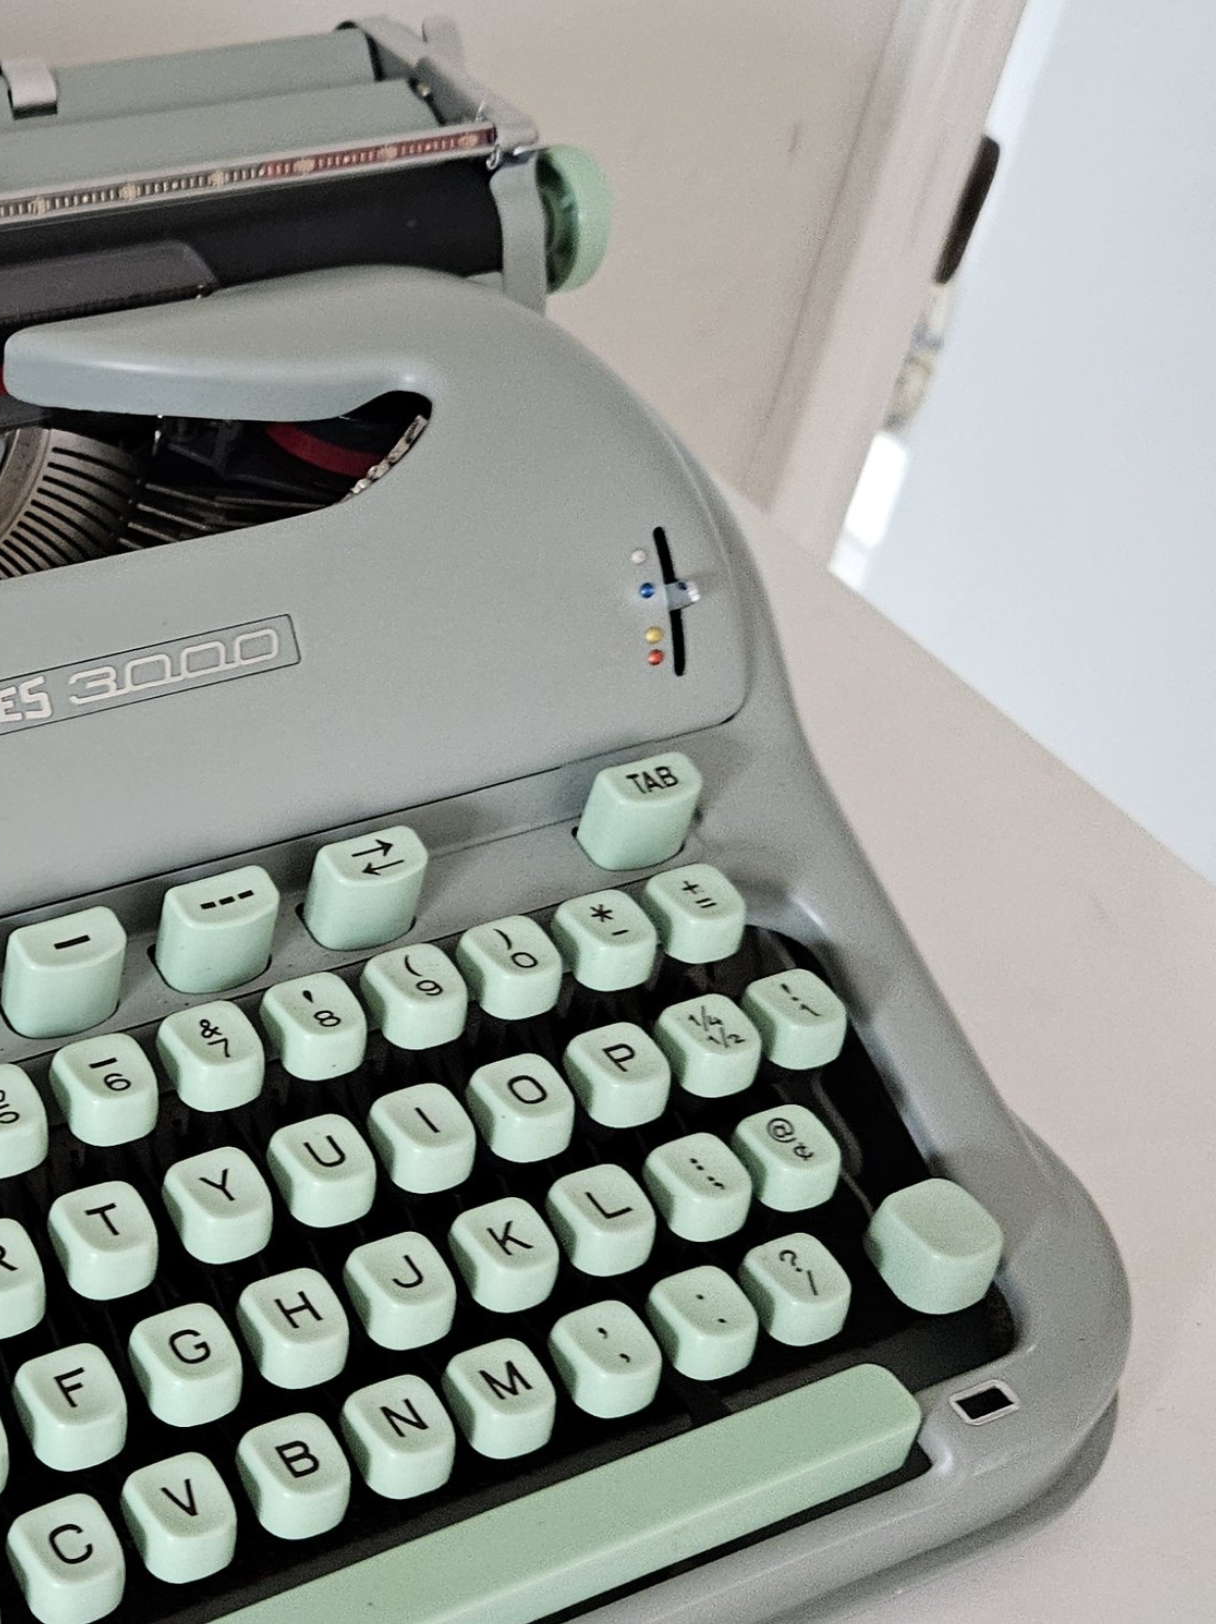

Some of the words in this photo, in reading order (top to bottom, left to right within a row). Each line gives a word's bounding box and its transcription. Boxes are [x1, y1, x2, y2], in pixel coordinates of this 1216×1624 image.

[68, 628, 279, 704] 3000
[626, 766, 679, 794] TAB
[414, 979, 444, 997] 9
[312, 1009, 342, 1028] 8
[205, 1036, 232, 1059] 7
[601, 1043, 636, 1073] P
[102, 1072, 132, 1092] 6
[766, 1117, 797, 1144] @
[302, 1134, 347, 1168] U
[198, 1168, 236, 1202] Y
[84, 1202, 121, 1237] T
[584, 1191, 634, 1220] L
[485, 1220, 534, 1257] K
[391, 1254, 425, 1289] J
[273, 1290, 324, 1330] H
[167, 1328, 212, 1365] G
[52, 1366, 85, 1409] F
[477, 1360, 534, 1401] M
[379, 1398, 430, 1438] N
[274, 1440, 321, 1479] B
[160, 1478, 199, 1517] V
[47, 1523, 94, 1565] C
